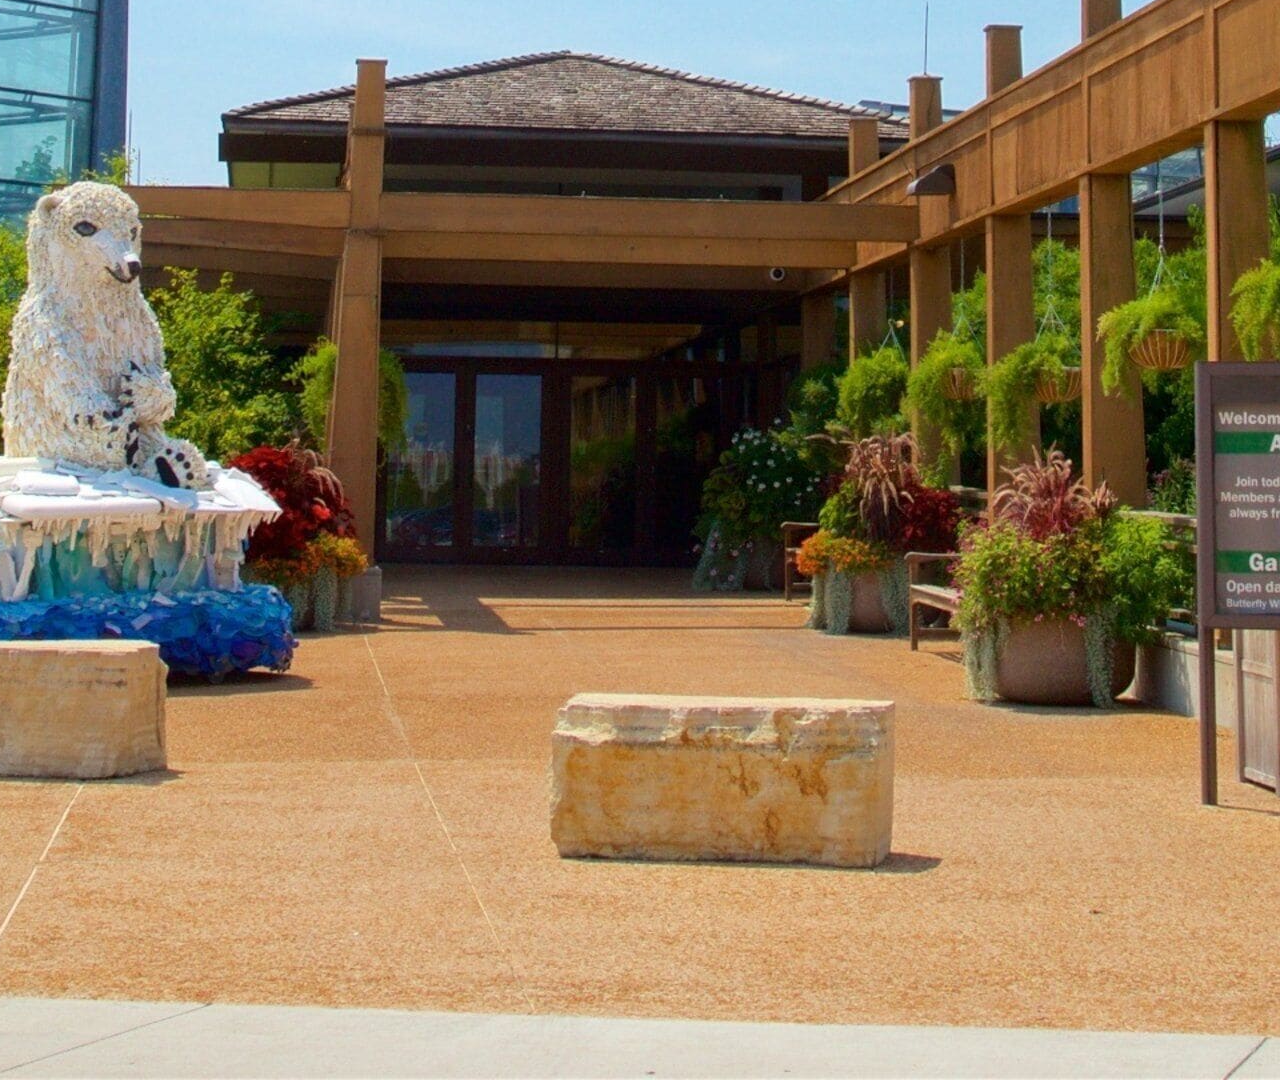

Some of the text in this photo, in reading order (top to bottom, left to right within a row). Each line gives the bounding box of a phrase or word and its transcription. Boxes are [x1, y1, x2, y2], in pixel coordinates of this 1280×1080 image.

[1235, 476, 1258, 488] Join
[1221, 491, 1275, 503] Members
[1229, 507, 1269, 521] always
[1226, 580, 1262, 594] Open
[1226, 599, 1268, 611] Butterfly
